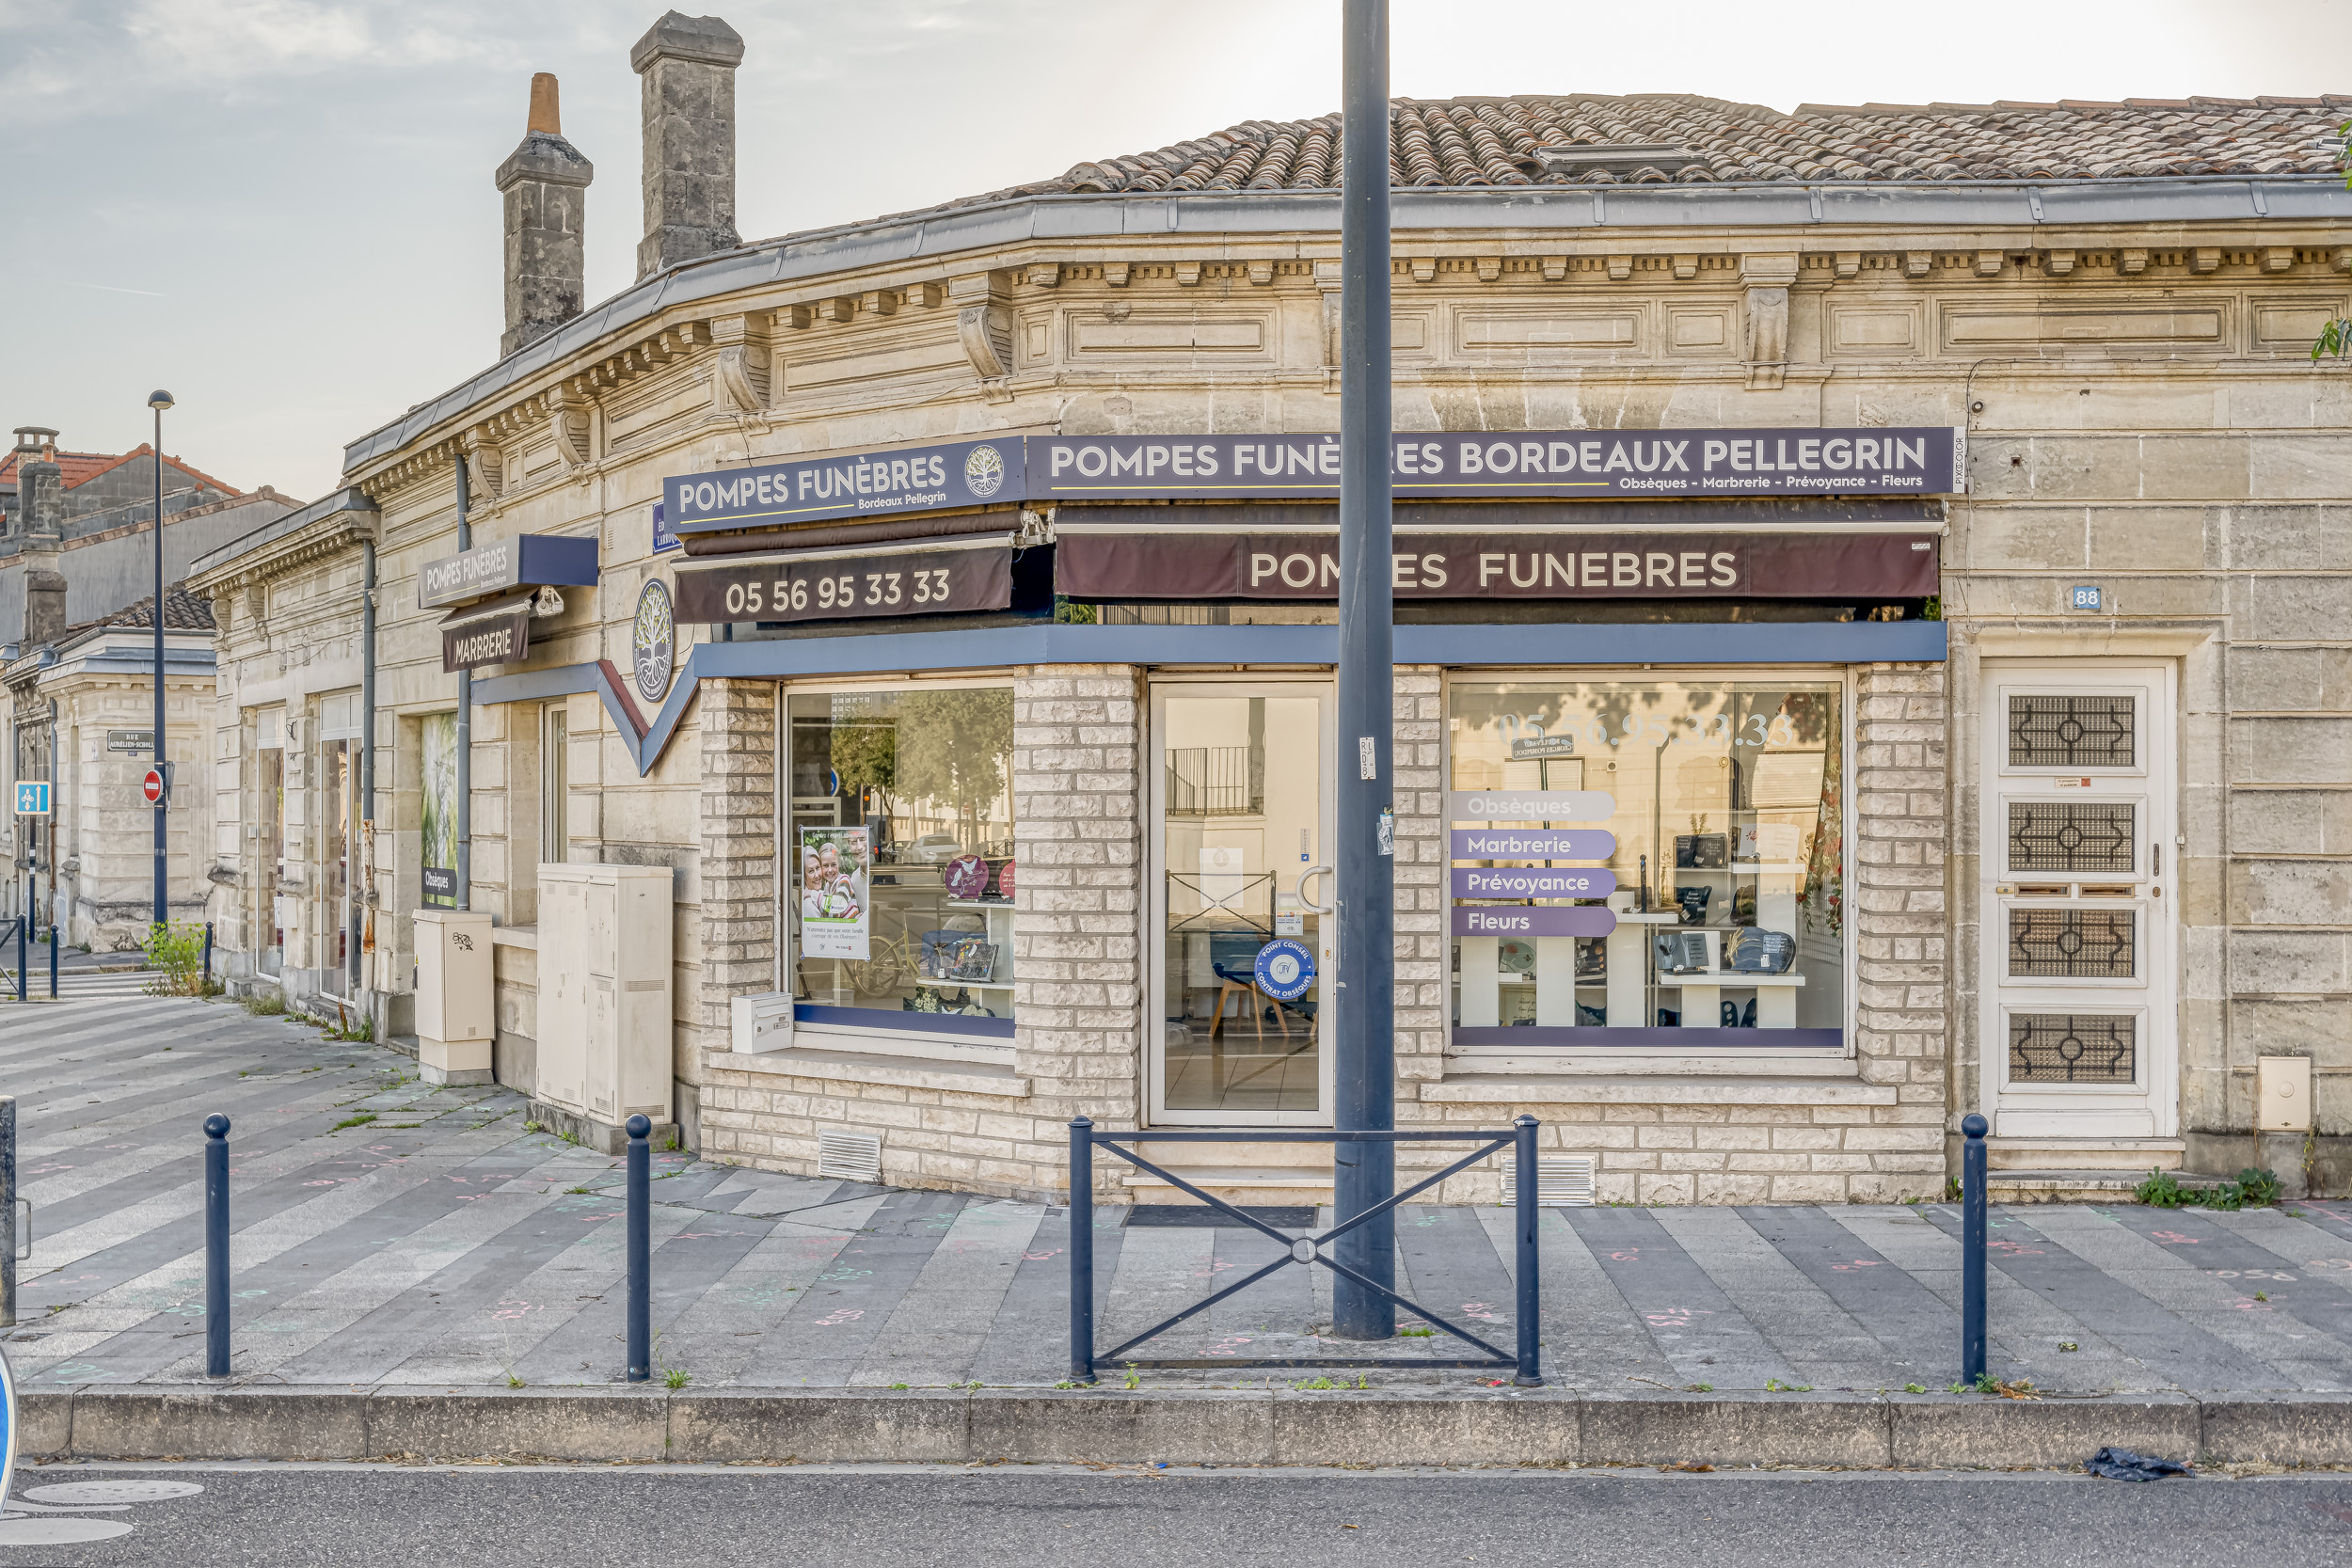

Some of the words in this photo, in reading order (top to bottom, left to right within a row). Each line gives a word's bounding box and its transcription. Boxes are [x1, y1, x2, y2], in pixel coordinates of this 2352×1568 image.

[1051, 445, 1219, 477] POMPES
[1234, 436, 1444, 476] FUNÈES
[1460, 440, 1691, 474] BORDEAUX
[1704, 437, 1925, 470] PELLEGRIN
[679, 473, 789, 513] POMPES
[799, 456, 946, 500] FUNÈBRES
[1619, 477, 1687, 491] Obsèques
[1703, 476, 1771, 488] Marbrerie
[1787, 475, 1867, 490] Prévoyance
[1882, 474, 1923, 486] Fleurs
[858, 495, 902, 510] Bordeaux
[905, 491, 946, 506] Pellegrin
[427, 561, 461, 592] POMPES
[463, 546, 507, 581] FUNÈBRES
[1251, 553, 1448, 588] POMES
[1480, 552, 1738, 588] FUNEBRES
[725, 583, 763, 614] 05
[772, 579, 808, 611] 56
[818, 577, 854, 609] 95
[865, 573, 901, 605] 33
[913, 569, 949, 602] 33
[2076, 591, 2098, 605] 88
[455, 628, 512, 664] MARBRERIE
[1468, 798, 1572, 817] Obsèques
[1468, 836, 1572, 853] Marbrerie
[425, 870, 449, 892] Obsèques
[1468, 874, 1590, 895] Prévoyance
[1468, 912, 1531, 929] Fleurs
[1262, 942, 1281, 958] POINT
[1283, 942, 1309, 959] CONSEIL
[1257, 972, 1280, 996] CONTRAT
